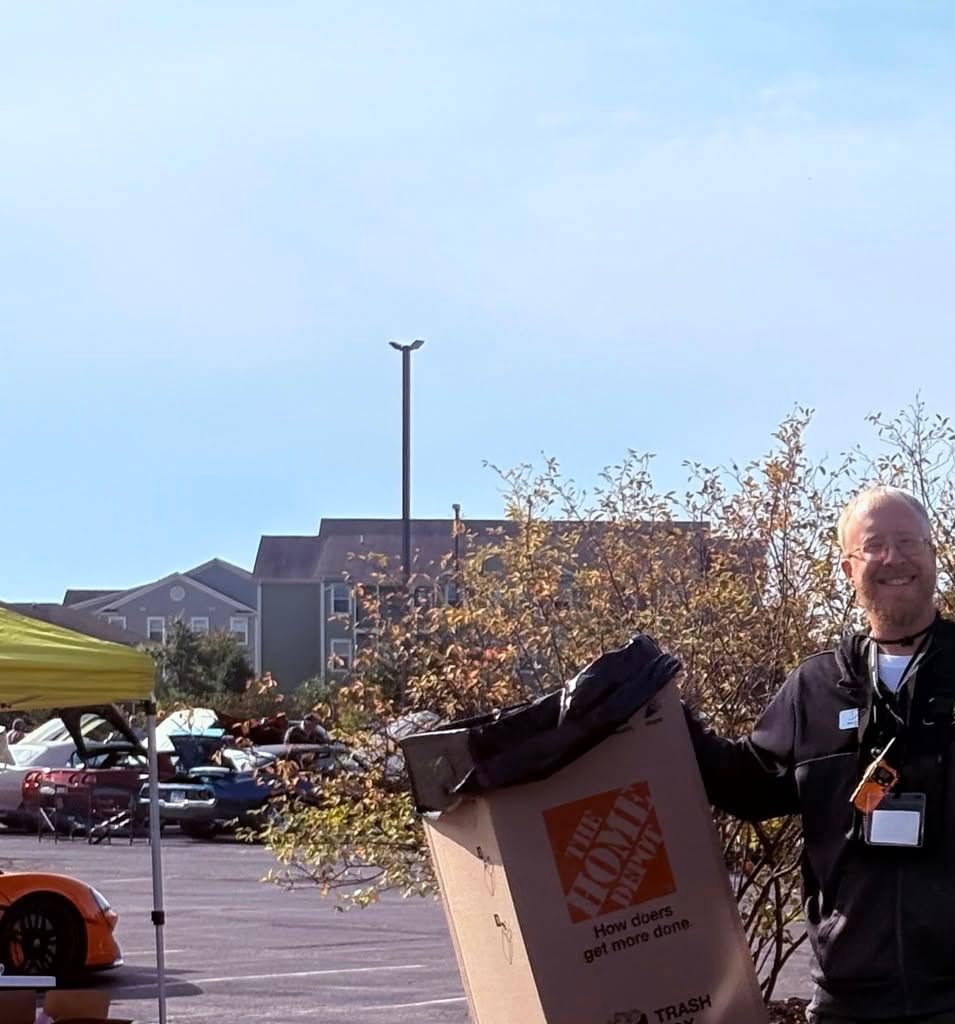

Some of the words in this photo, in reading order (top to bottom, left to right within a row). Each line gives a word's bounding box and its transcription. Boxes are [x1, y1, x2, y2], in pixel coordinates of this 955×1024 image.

[564, 810, 603, 861] THE
[567, 785, 654, 916] HOME
[610, 824, 663, 907] DEPOT
[594, 921, 627, 939] How
[631, 905, 674, 927] doers
[584, 943, 608, 963] get
[612, 932, 649, 951] more
[654, 994, 712, 1023] TRASH
